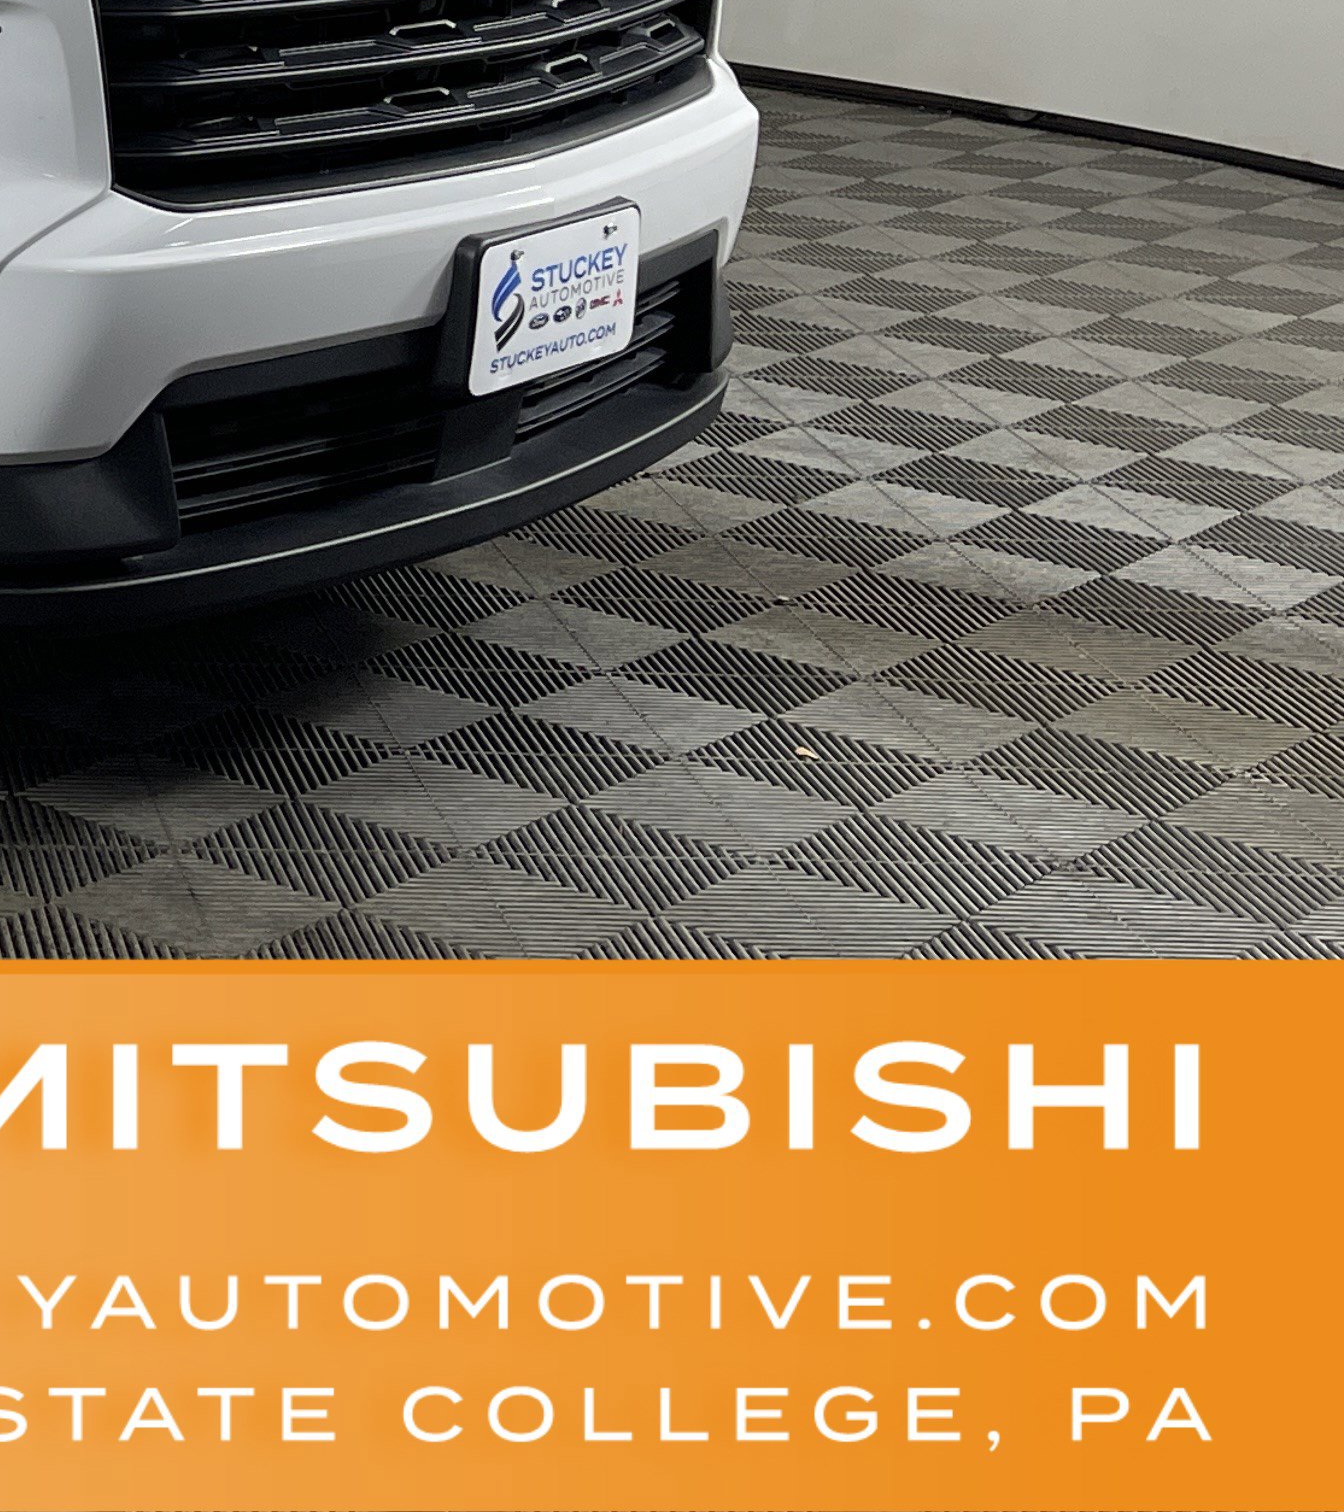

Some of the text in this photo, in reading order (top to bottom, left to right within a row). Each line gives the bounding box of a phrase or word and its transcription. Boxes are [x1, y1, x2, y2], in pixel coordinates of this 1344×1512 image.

[529, 268, 625, 310] AUTOMOTIVE
[531, 242, 628, 292] STUCKEY
[489, 322, 617, 374] STUCKEYAUTO.COM
